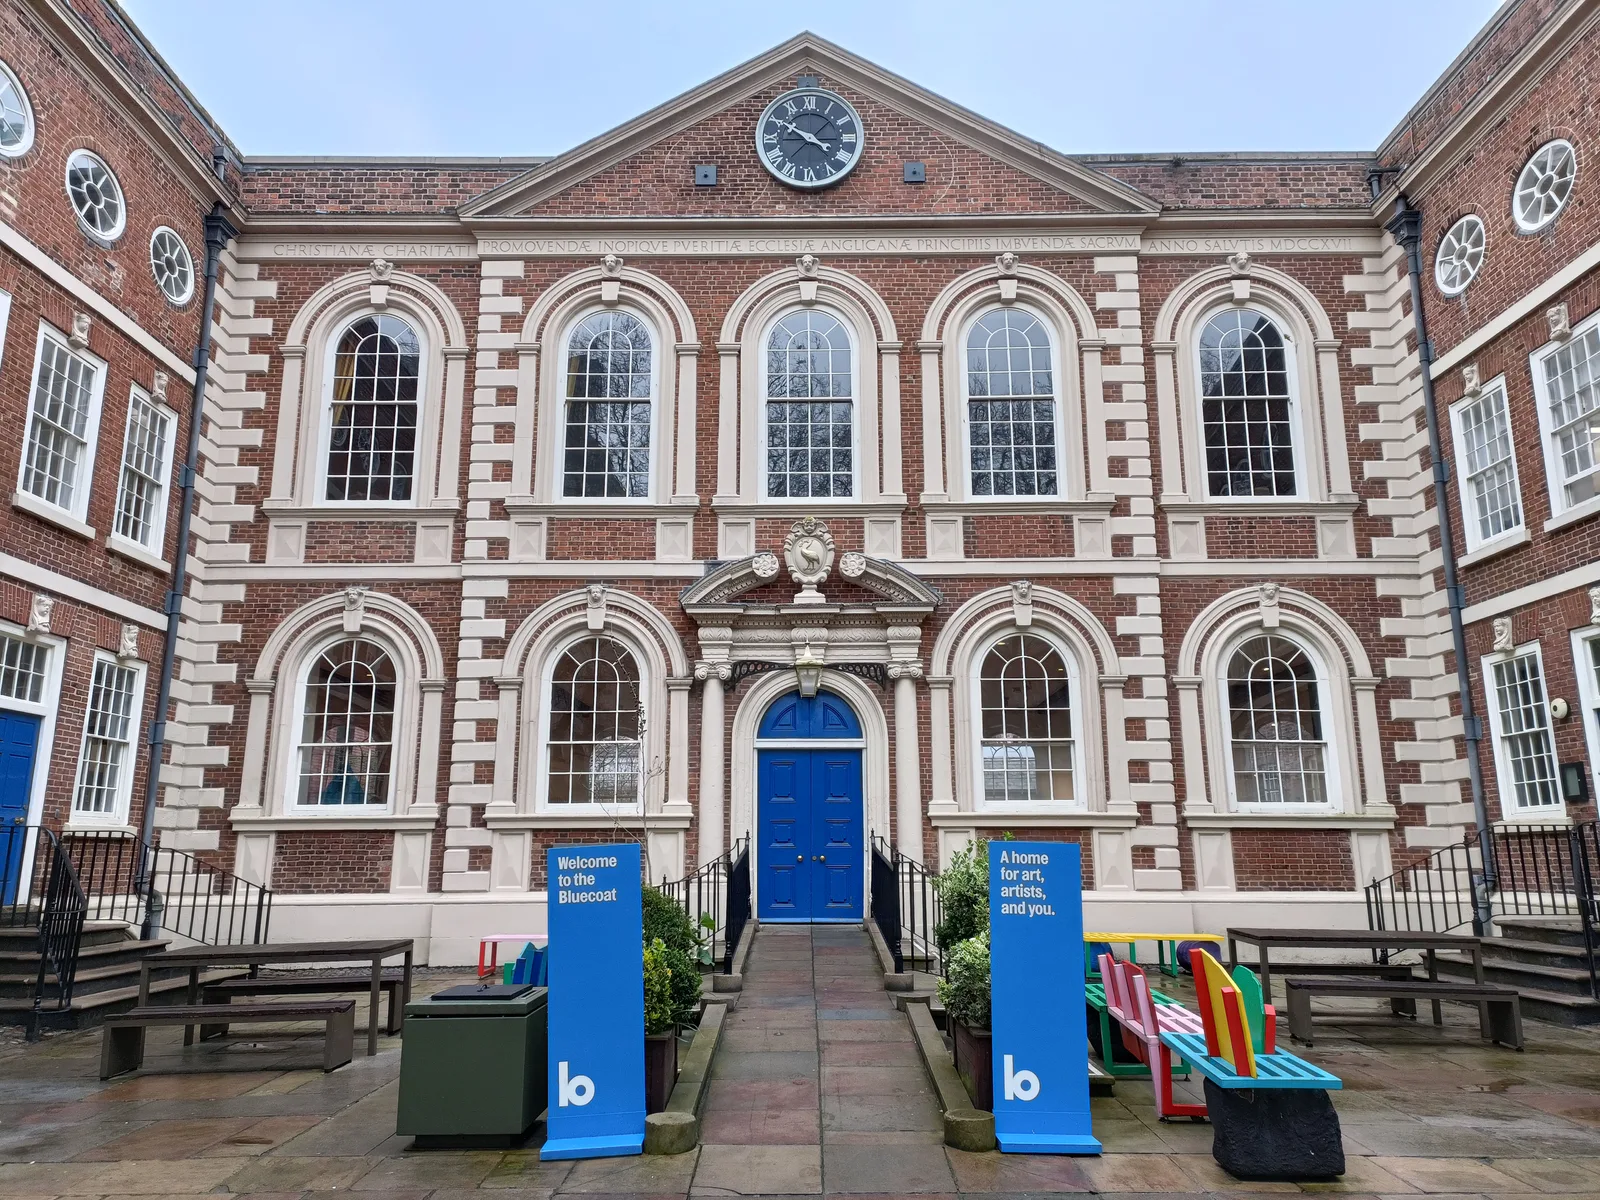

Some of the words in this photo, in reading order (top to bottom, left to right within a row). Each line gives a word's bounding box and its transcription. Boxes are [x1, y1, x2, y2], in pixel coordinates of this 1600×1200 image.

[783, 100, 798, 115] XI
[803, 97, 816, 109] XII
[825, 101, 834, 114] I
[768, 114, 783, 126] X
[836, 114, 851, 125] II
[763, 132, 777, 143] IX
[842, 133, 856, 142] III
[766, 147, 783, 167] VIII
[835, 148, 852, 164] IIII
[781, 161, 796, 179] VII
[803, 168, 817, 180] VI
[825, 162, 836, 176] V
[273, 244, 374, 257] CHRISTIANÆ
[383, 244, 471, 257] CHARITATI
[483, 241, 592, 253] PROMOVENDÆ
[749, 240, 816, 252] ECCLESIÆ
[821, 239, 912, 252] ANGLICANÆ
[917, 239, 991, 251] PRINCIPIIS
[1080, 237, 1137, 249] SACRVM
[1148, 240, 1198, 252] ANNO
[1204, 239, 1264, 252] SALVTIS
[1271, 238, 1352, 251] MDCCXVII
[558, 857, 617, 870] Welcome
[1000, 851, 1010, 864] A
[1011, 850, 1049, 865] home
[558, 874, 573, 887] to
[573, 873, 595, 886] the
[1000, 867, 1020, 881] for
[1021, 868, 1045, 884] art,
[558, 888, 617, 904] Bluecoat
[1000, 884, 1047, 900] artists,
[1001, 902, 1028, 915] and
[1028, 903, 1056, 918] you.
